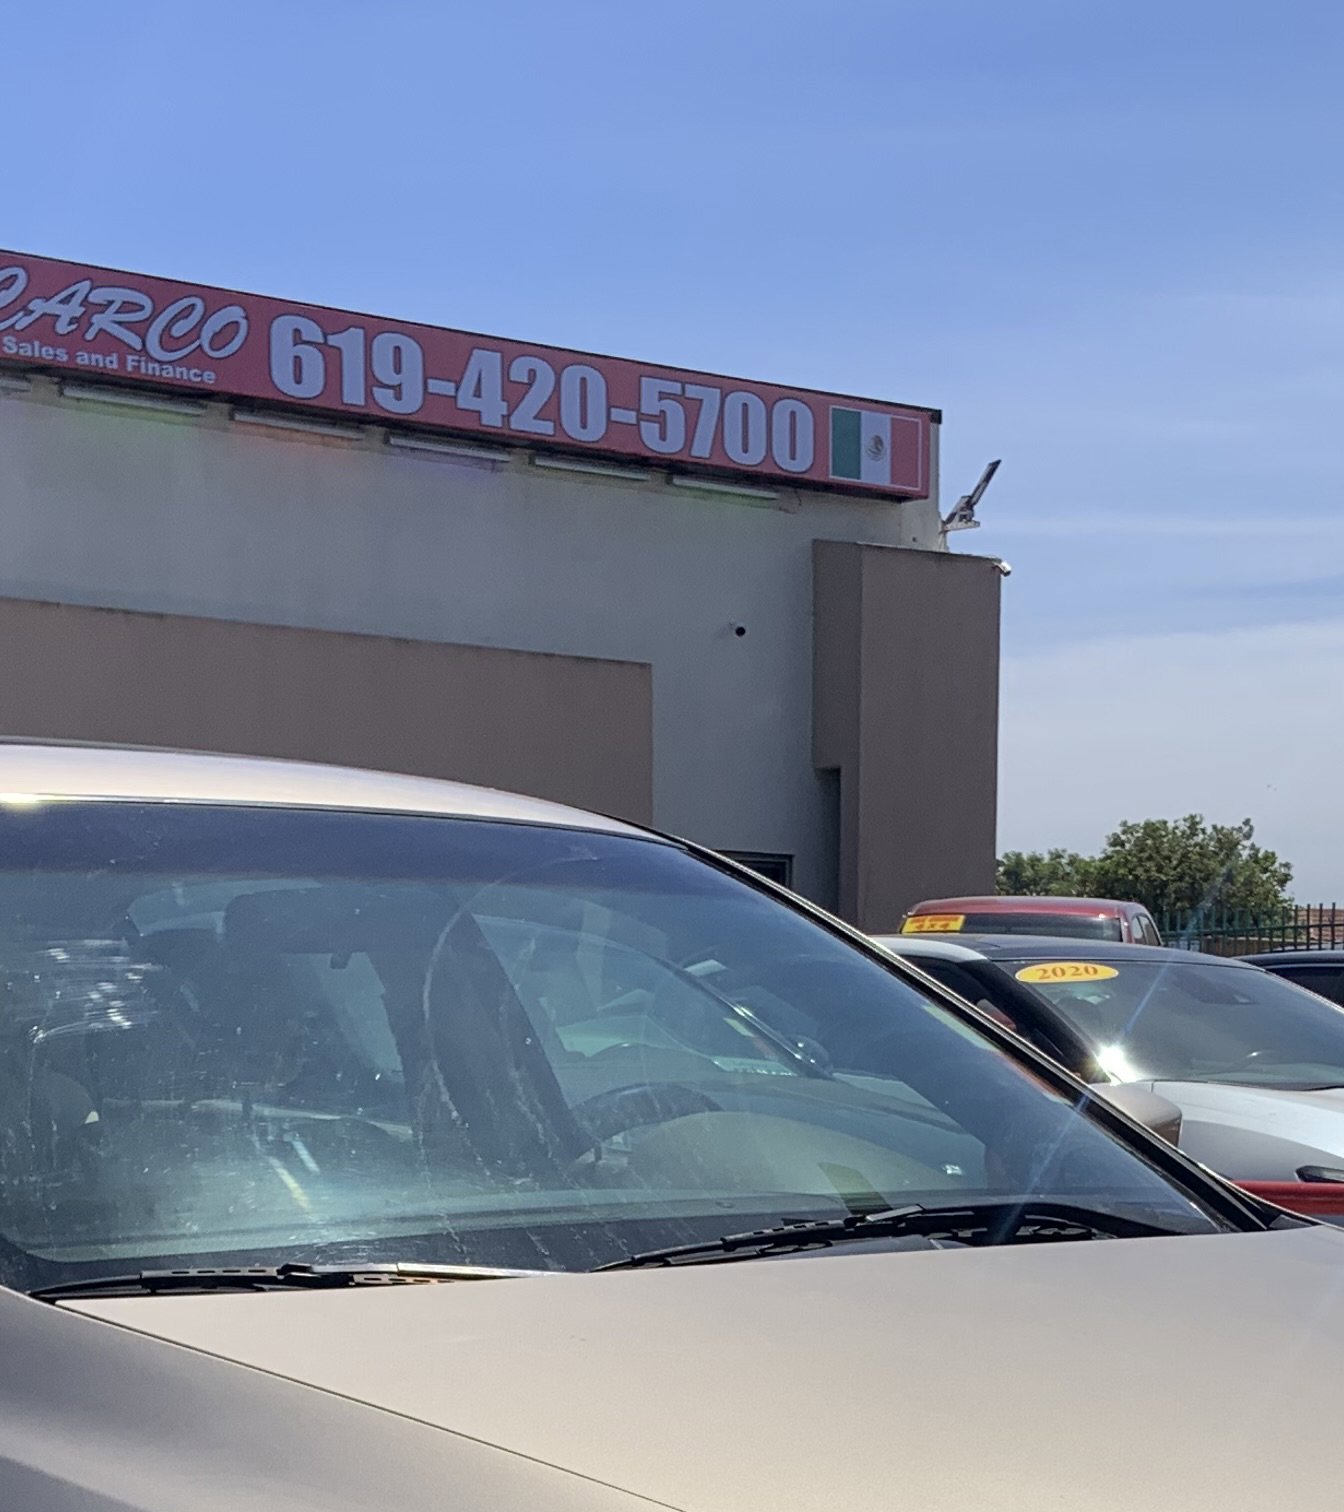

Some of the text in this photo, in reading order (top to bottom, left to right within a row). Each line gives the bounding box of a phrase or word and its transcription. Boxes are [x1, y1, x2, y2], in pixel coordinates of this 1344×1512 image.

[2, 335, 217, 385] Sales and Finance
[269, 314, 814, 473] 619-420-5700
[1037, 965, 1098, 980] 2020
